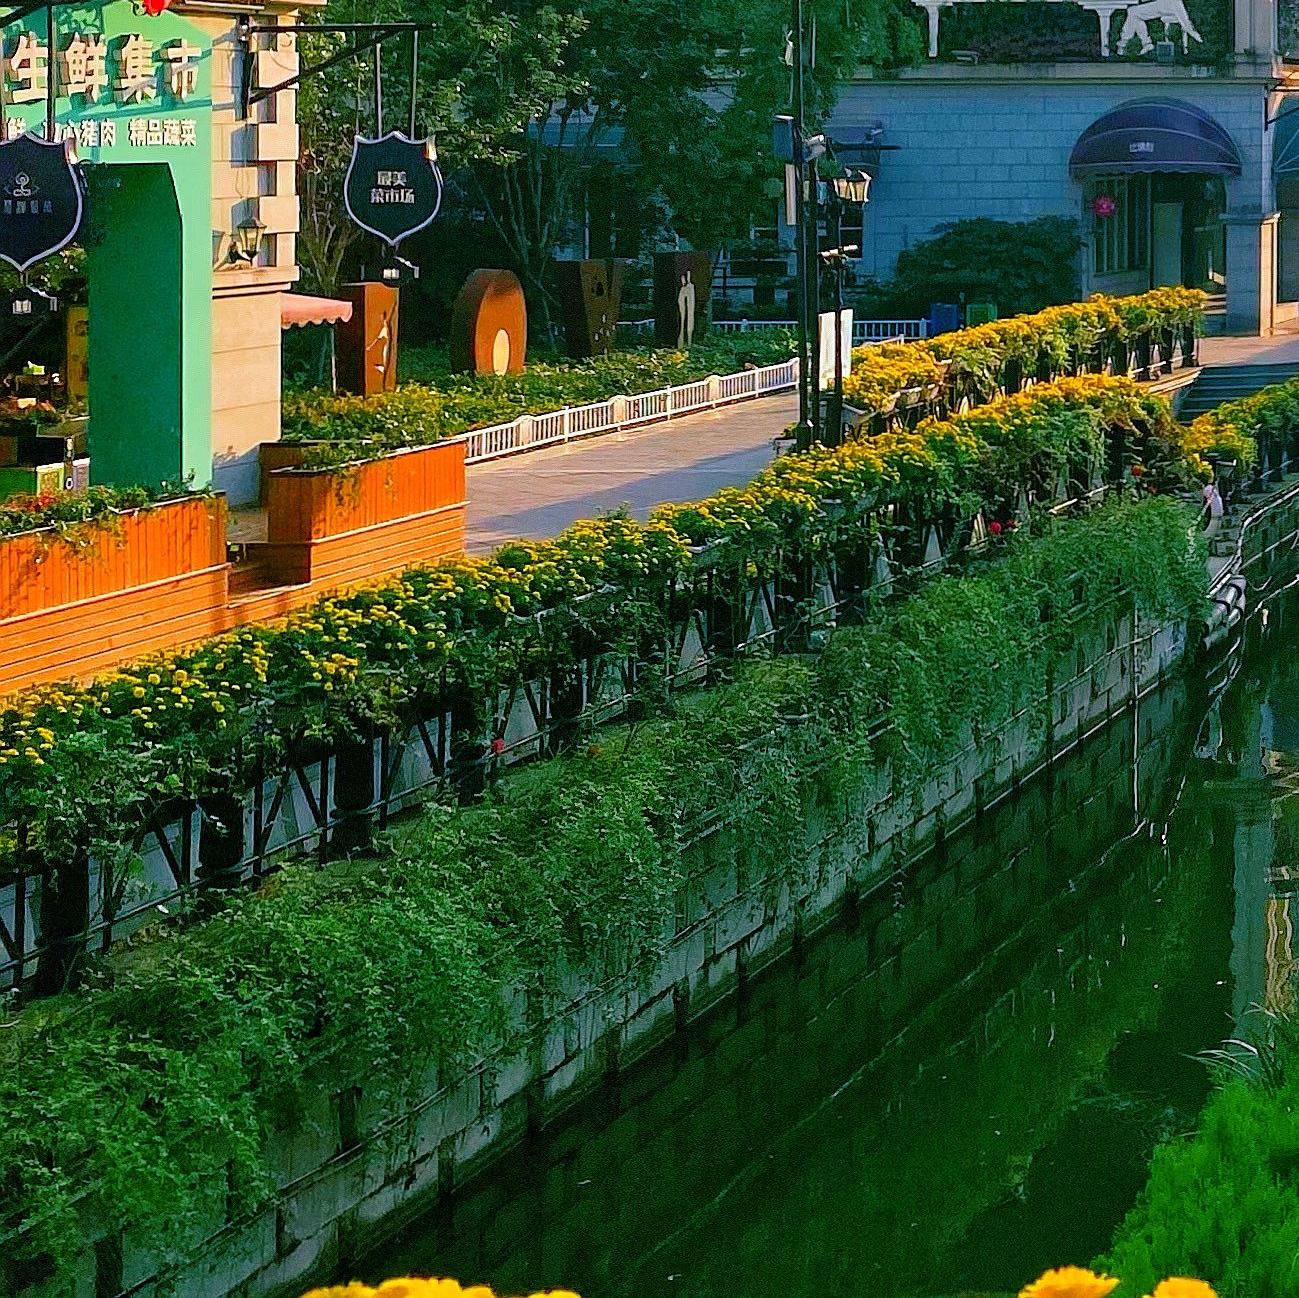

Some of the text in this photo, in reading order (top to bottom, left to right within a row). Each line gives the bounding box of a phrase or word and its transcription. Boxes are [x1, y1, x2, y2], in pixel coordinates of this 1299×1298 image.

[10, 31, 202, 104] 生鲜集市
[128, 118, 197, 148] 精品蔬菜
